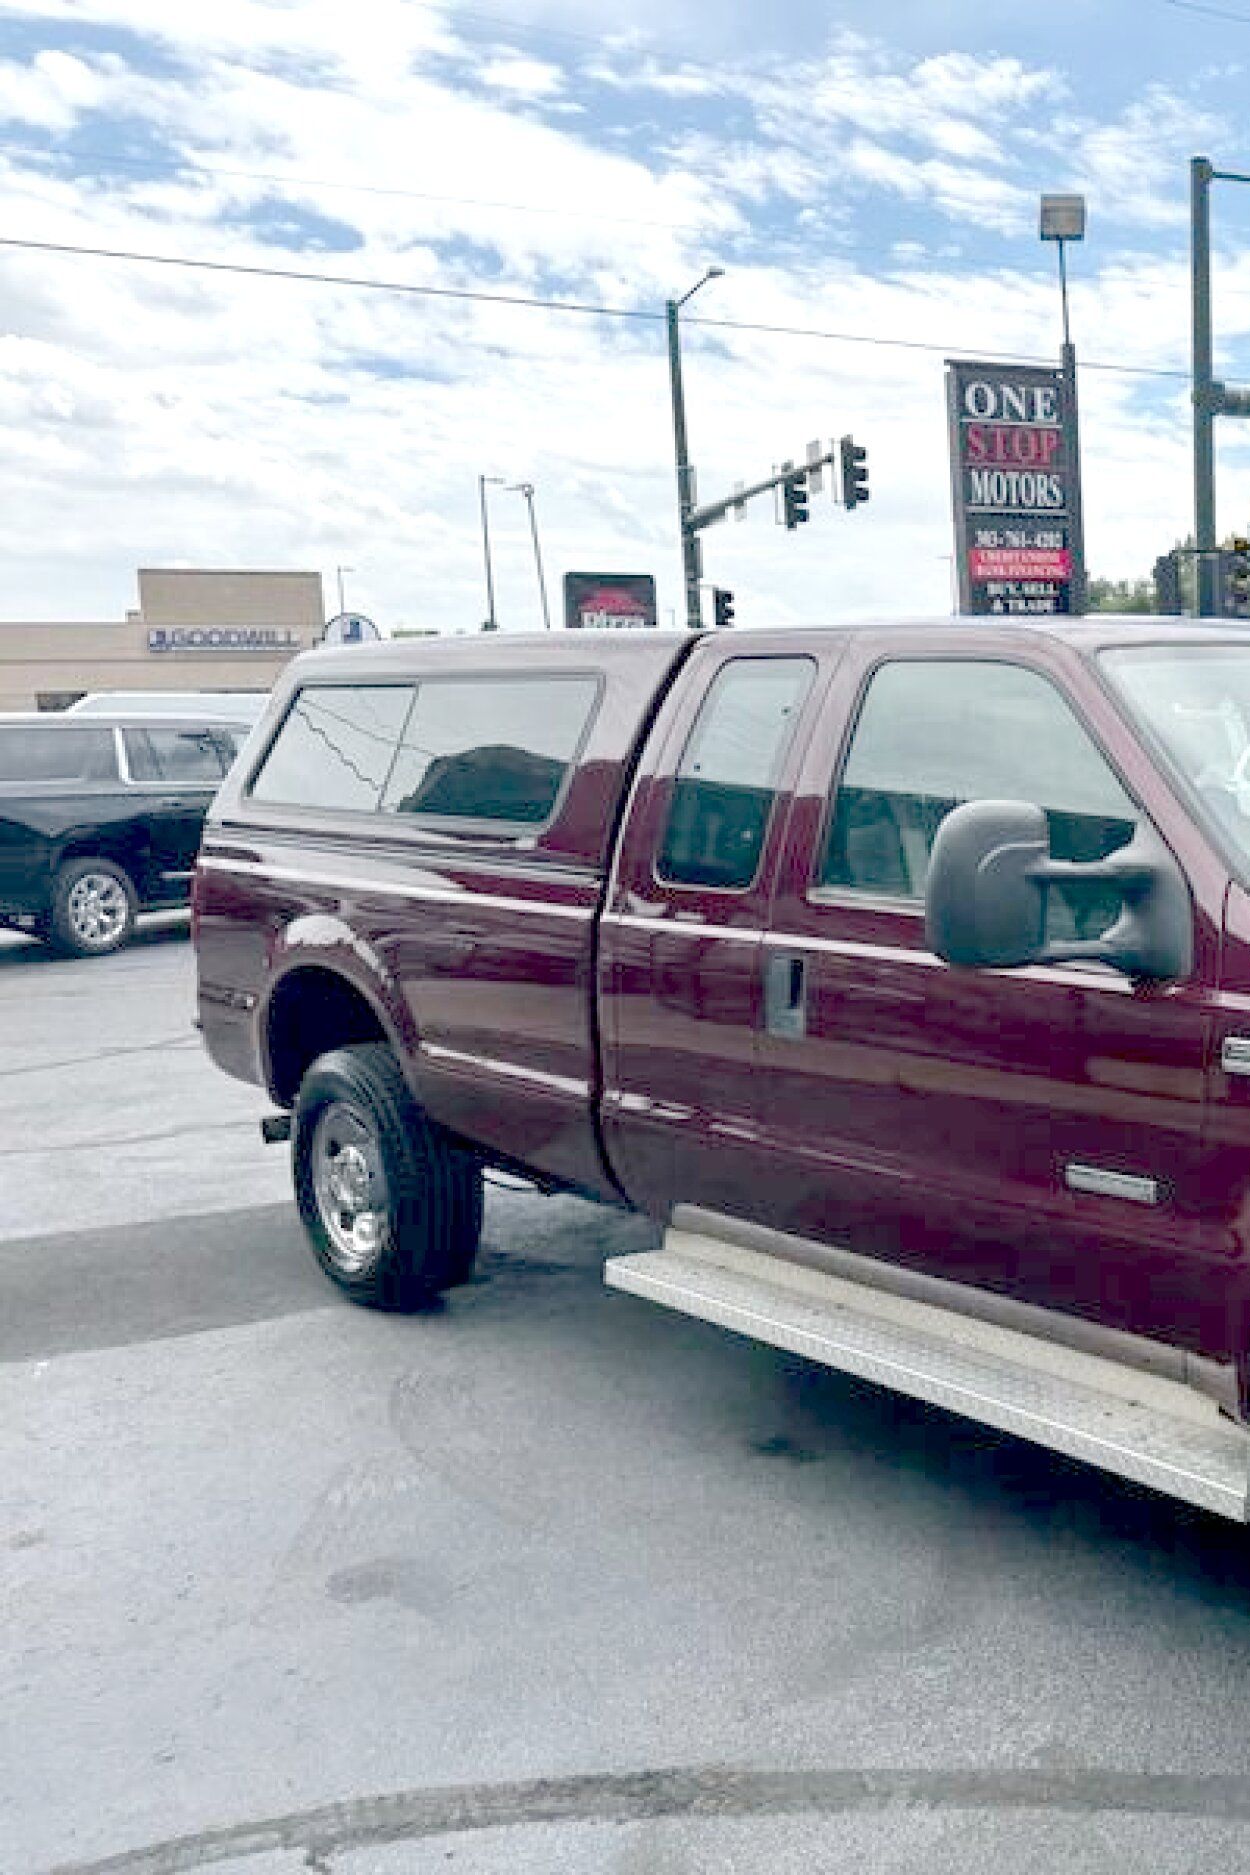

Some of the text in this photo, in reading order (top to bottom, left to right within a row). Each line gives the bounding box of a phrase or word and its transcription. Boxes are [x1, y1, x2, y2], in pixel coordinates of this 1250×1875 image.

[965, 381, 1058, 422] ONE
[968, 425, 1059, 463] STOP
[971, 470, 1064, 508] MOTORS
[171, 628, 301, 647] GOODWILL
